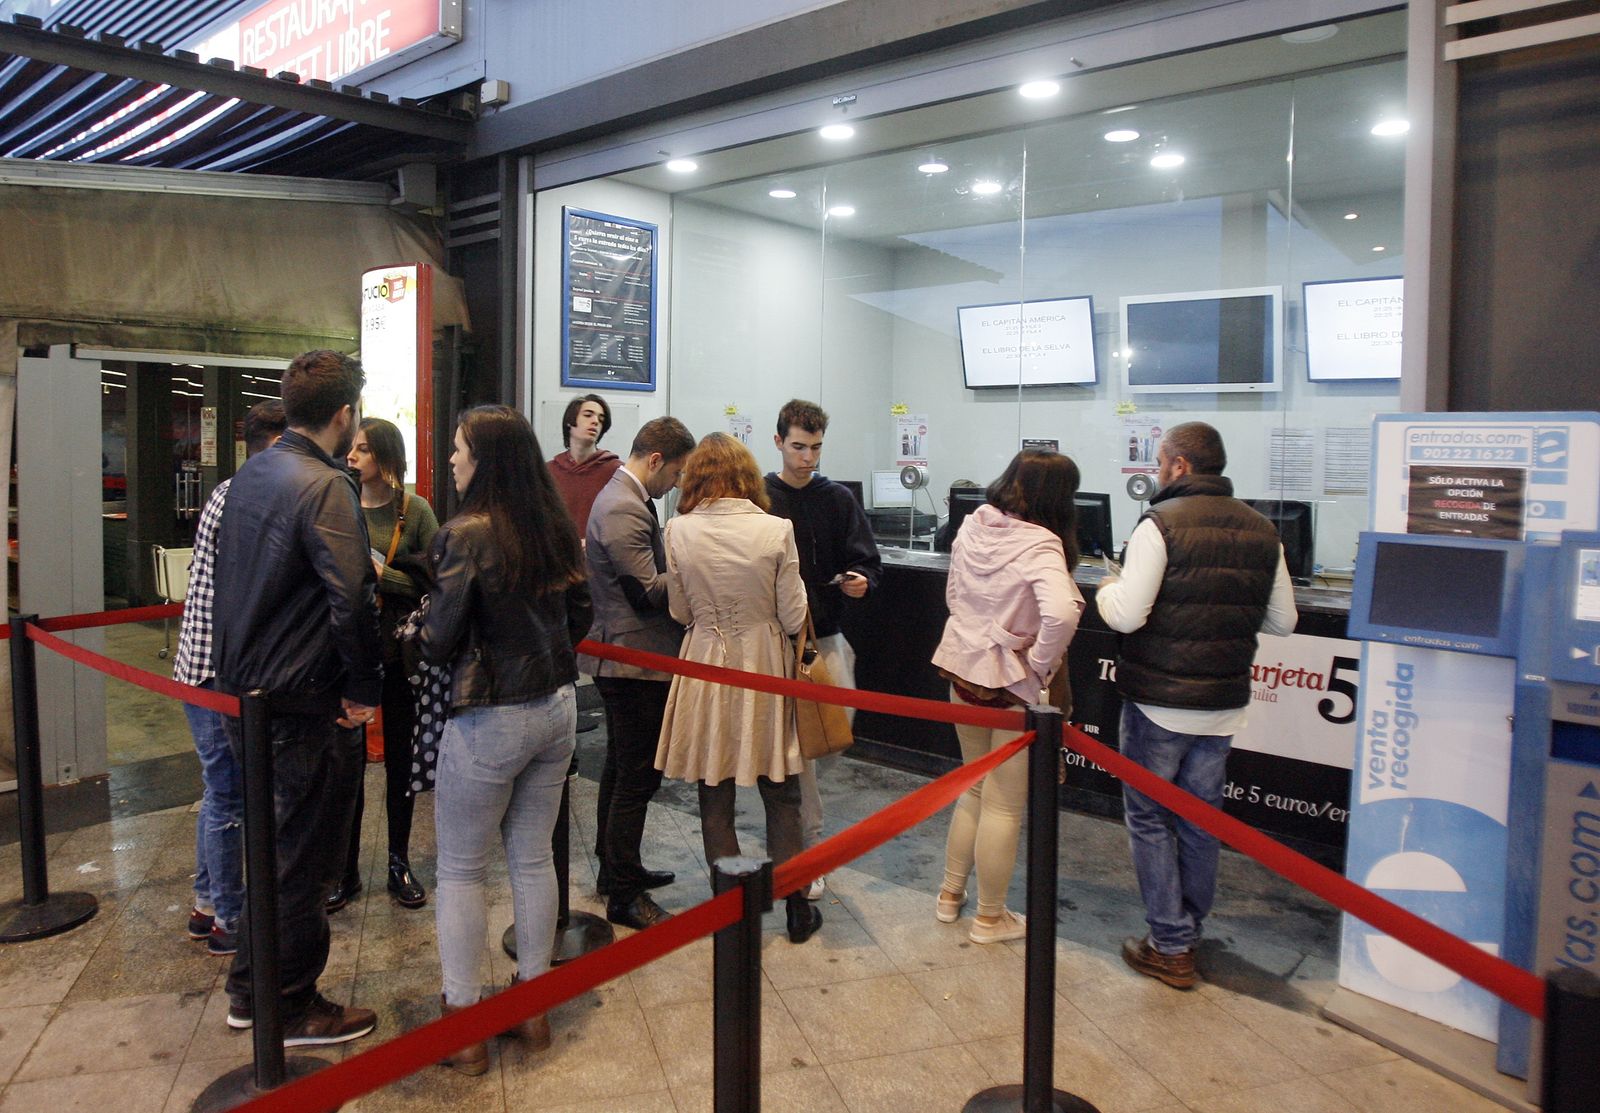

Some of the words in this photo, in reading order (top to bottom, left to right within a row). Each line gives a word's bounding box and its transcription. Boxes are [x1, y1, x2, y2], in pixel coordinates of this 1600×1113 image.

[243, 0, 368, 66] RESTAURA
[325, 9, 392, 82] LIBRE
[1353, 331, 1388, 340] LIBRO
[993, 346, 1017, 354] LIBRO
[1043, 343, 1071, 351] SELVA
[1410, 431, 1523, 444] entradas.com
[1423, 448, 1451, 459] 902
[1453, 448, 1473, 459] 22
[1476, 449, 1493, 460] 16
[1495, 449, 1515, 460] 22
[1428, 475, 1454, 485] SÓLO
[1454, 477, 1489, 487] ACTIVA
[1491, 479, 1505, 487] LA
[1447, 488, 1484, 498] OPCIÓN
[1434, 500, 1481, 510] RECOGIDA
[1482, 502, 1497, 511] DE
[1439, 511, 1489, 522] ENTRADAS
[1249, 662, 1326, 692] arjeta
[1317, 655, 1361, 725] 5
[1084, 723, 1100, 735] SUR
[1385, 662, 1420, 791] recogida
[1366, 709, 1390, 790] venta
[1222, 781, 1245, 800] de
[1247, 785, 1262, 803] 5
[1555, 810, 1600, 969] as.com
